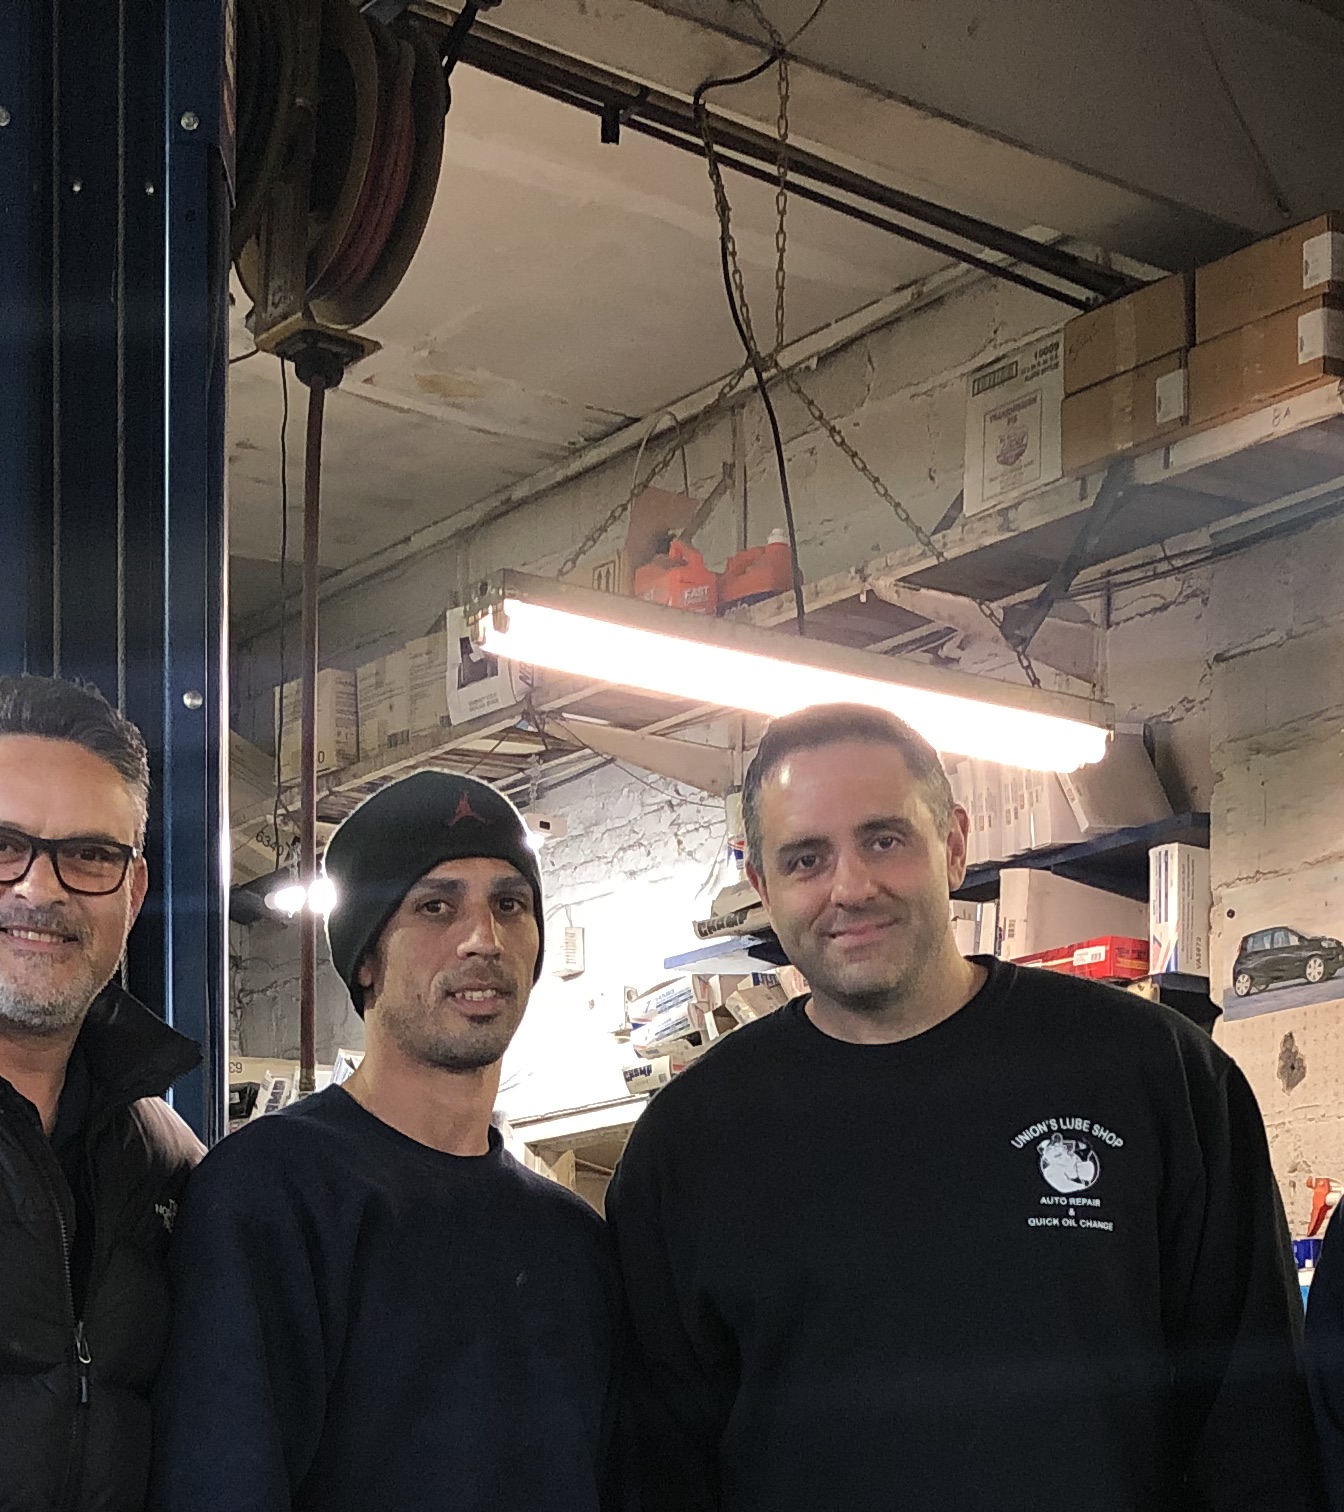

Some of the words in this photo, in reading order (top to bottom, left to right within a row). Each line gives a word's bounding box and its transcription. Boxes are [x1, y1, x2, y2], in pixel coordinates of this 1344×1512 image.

[697, 910, 748, 938] CHAMP
[1011, 1118, 1058, 1149] UNION'S
[1060, 1117, 1090, 1132] LUBE
[1091, 1123, 1124, 1149] SHOP
[1040, 1196, 1067, 1206] AUTO
[1068, 1197, 1101, 1208] REPAIR
[1068, 1207, 1076, 1216] &
[1027, 1217, 1060, 1227] QUICK
[1061, 1217, 1078, 1228] OIL
[1079, 1218, 1114, 1232] CHANGE
